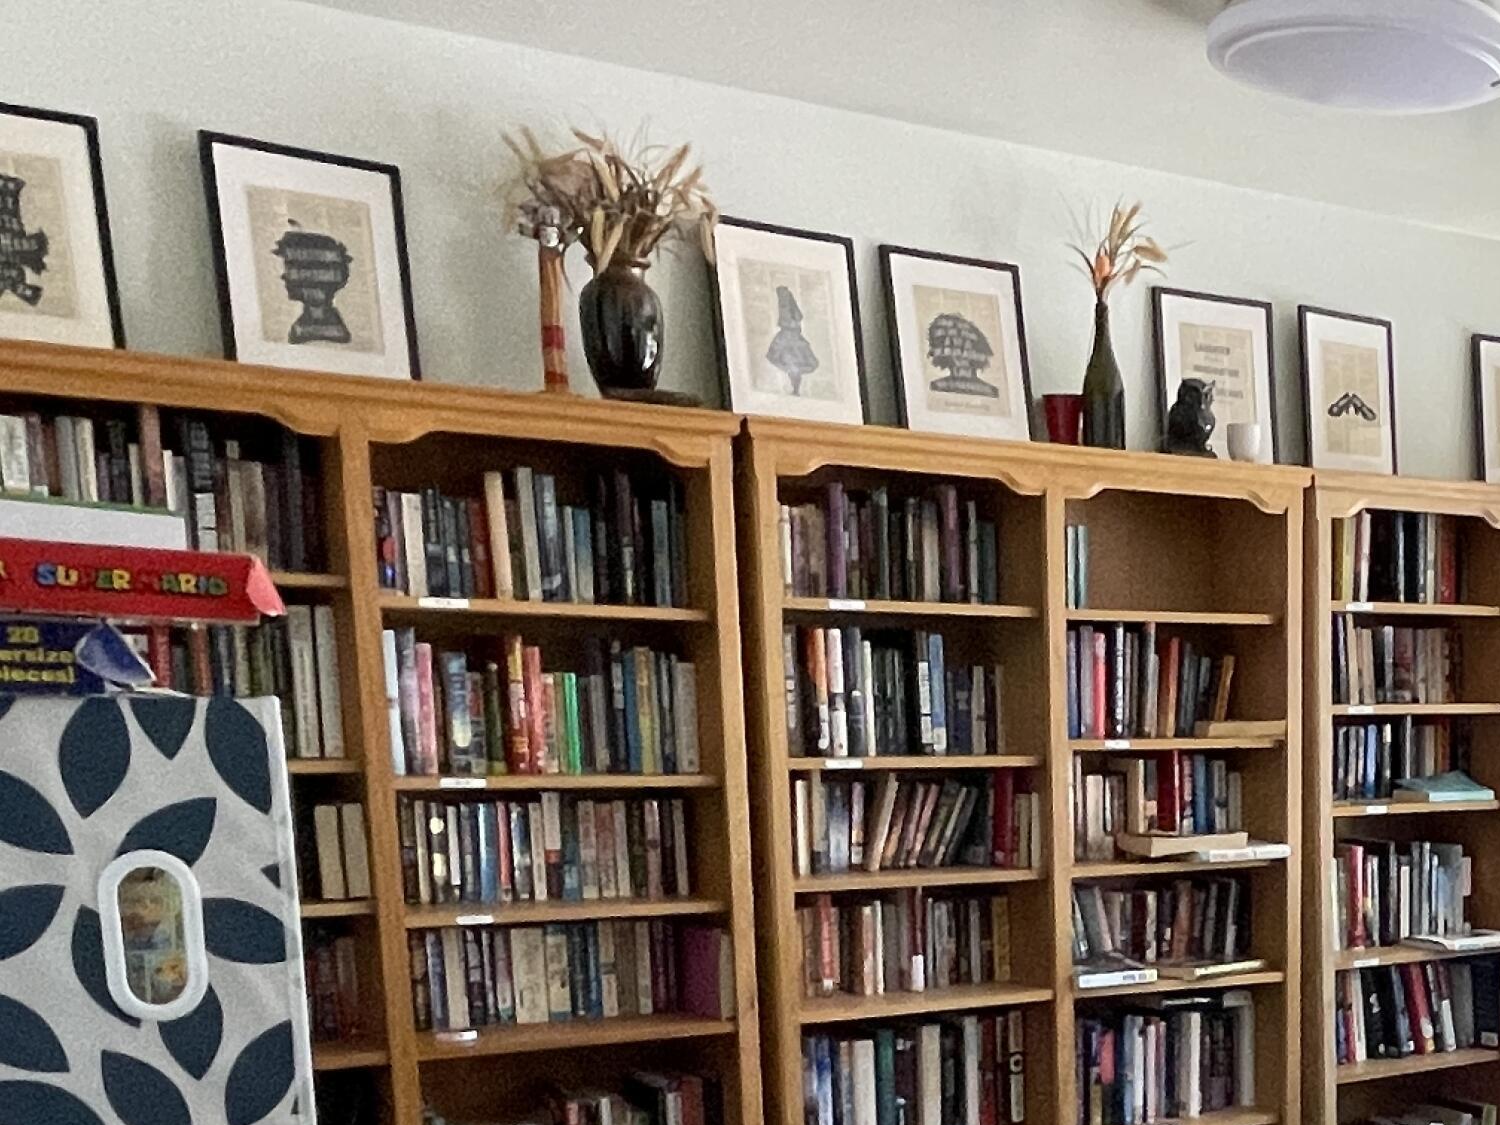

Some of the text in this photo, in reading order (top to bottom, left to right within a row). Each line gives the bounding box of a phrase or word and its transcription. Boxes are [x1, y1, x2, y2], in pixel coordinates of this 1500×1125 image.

[36, 562, 131, 590] SUPER
[136, 569, 229, 597] MARIO
[0, 664, 75, 684] ieces!
